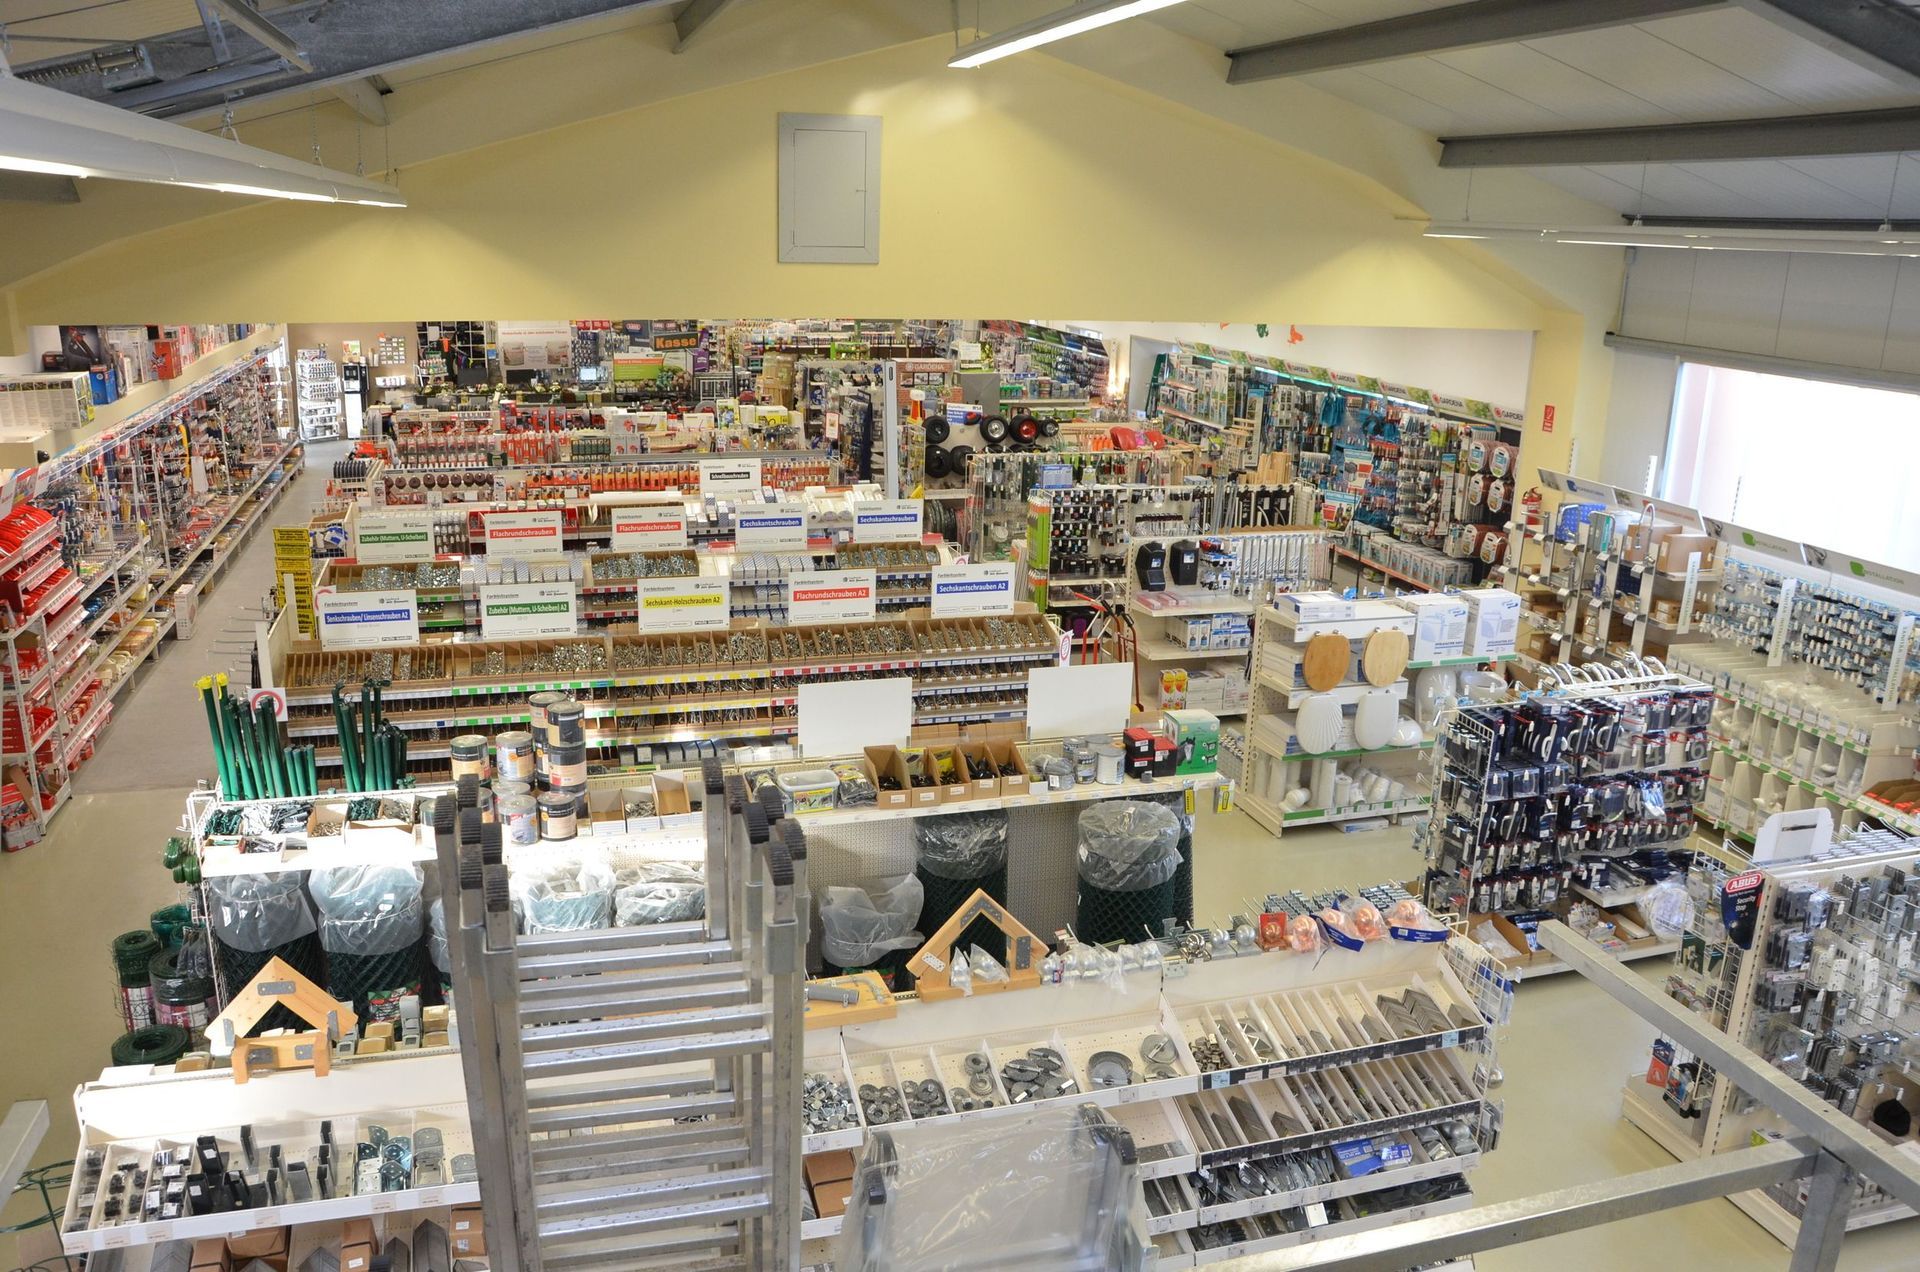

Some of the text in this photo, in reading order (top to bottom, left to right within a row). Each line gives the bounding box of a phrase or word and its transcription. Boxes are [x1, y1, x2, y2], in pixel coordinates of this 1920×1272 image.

[655, 337, 697, 349] Kasse
[742, 520, 800, 528] Sechskantschrauben
[860, 515, 915, 523] Sechskantschrauben
[619, 523, 679, 532] Flachrundschrauben
[492, 529, 554, 537] Flachrundschrauben
[361, 535, 380, 543] Zubehör
[939, 583, 997, 593] Sechskantschrauben
[796, 589, 867, 600] Flachrundschrauben A2
[645, 597, 713, 607] Sechskant-Holzschrauben
[488, 606, 509, 615] Zubehör
[509, 606, 531, 615] (Muttern,
[532, 604, 560, 613] U-Scheiben)
[326, 613, 363, 623] Senkschrauben/
[363, 612, 401, 621] Linsenschrauben
[1679, 707, 1690, 726] 2
[1690, 742, 1705, 760] 6
[1730, 876, 1758, 890] ABUS
